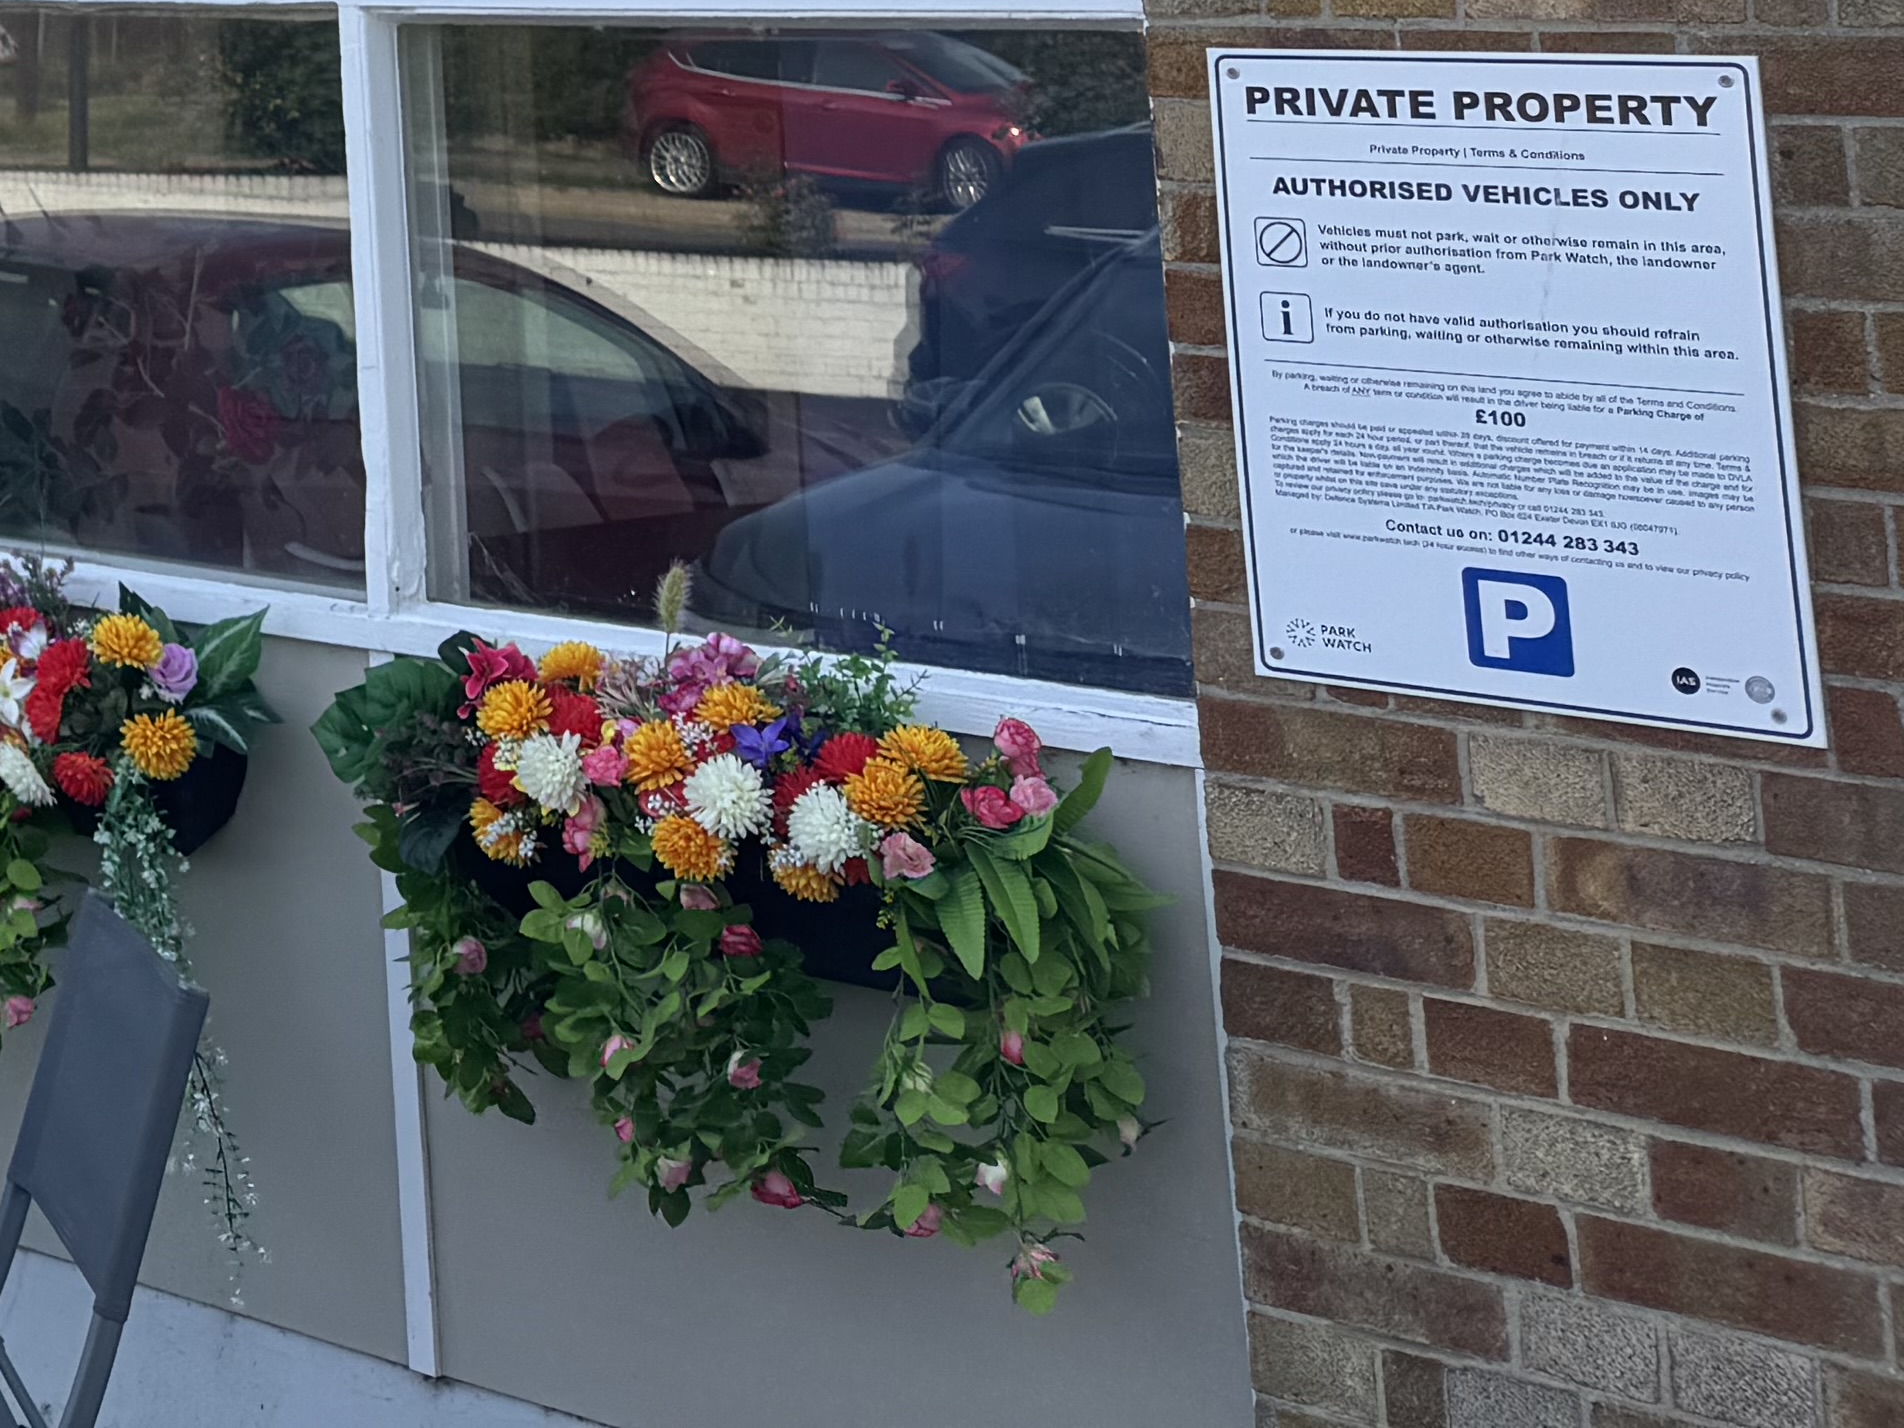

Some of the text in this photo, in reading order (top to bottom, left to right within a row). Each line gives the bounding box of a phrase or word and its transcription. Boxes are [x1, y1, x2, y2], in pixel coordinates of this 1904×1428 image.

[1246, 86, 1715, 126] PRIVATE PROPERTY
[1369, 144, 1409, 155] Private
[1411, 145, 1461, 159] Property
[1469, 147, 1506, 158] Terms
[1508, 148, 1518, 159] &
[1520, 149, 1585, 161] Conditions
[1273, 177, 1699, 212] AUTHORISED VEHICLES ONLY
[1317, 224, 1726, 256] Vehicles must not park, wait or otherwise remain in this area,
[1319, 240, 1716, 270] without prior authorisation from Park Watch, the landowner
[1321, 255, 1485, 275] or the landowner's agent.
[1324, 307, 1700, 341] If you do not have valid authorisation you should refrain
[1325, 322, 1739, 360] from parking, waiting or otherwise remaining within this area.
[1475, 408, 1526, 428] £100
[1616, 406, 1654, 419] Parking
[1656, 409, 1692, 422] Charge
[1385, 519, 1640, 556] Contact us on: 01244 283 343
[1320, 624, 1356, 639] PARK
[1322, 637, 1372, 653] WATCH
